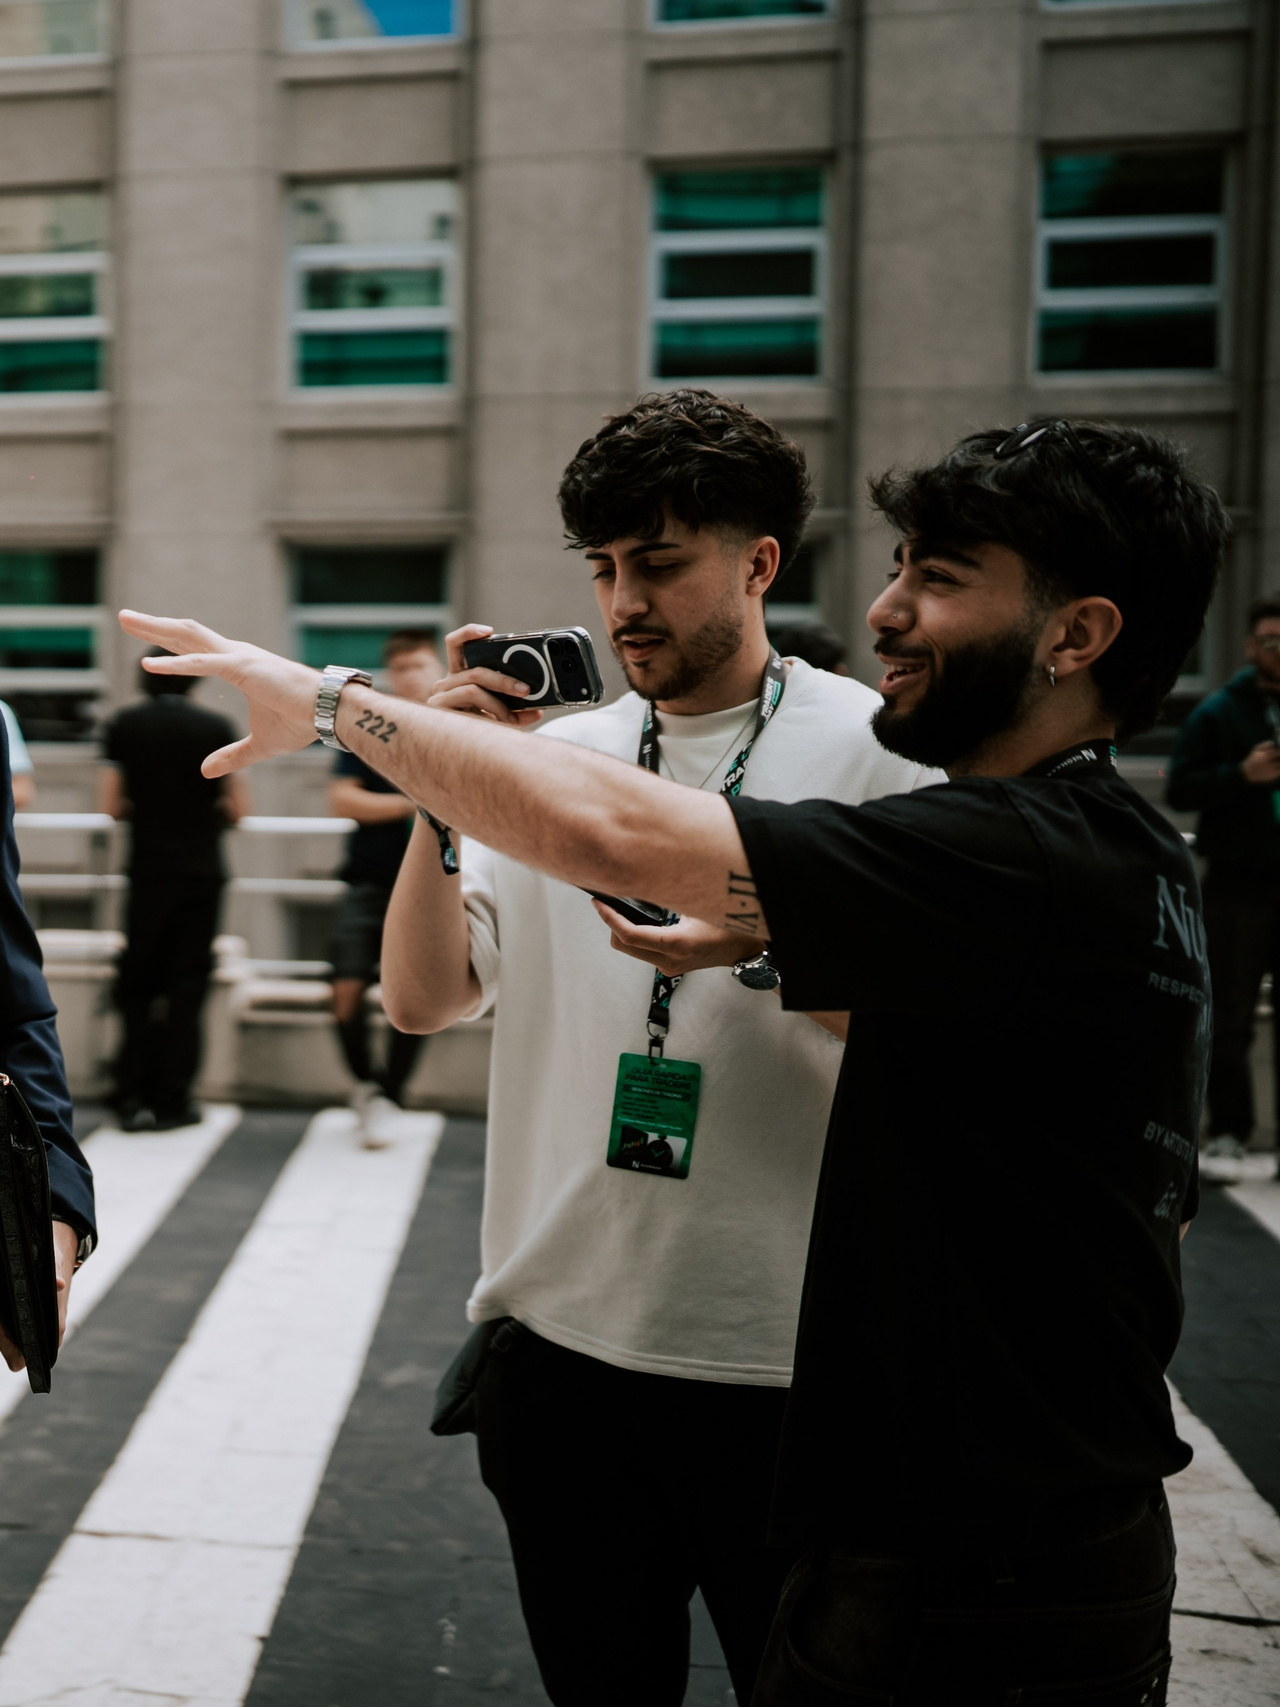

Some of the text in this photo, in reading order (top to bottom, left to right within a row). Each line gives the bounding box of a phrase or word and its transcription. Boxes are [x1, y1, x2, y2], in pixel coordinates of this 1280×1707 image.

[761, 676, 775, 717] TRADERS
[355, 709, 398, 744] 222
[625, 1073, 691, 1090] PARA TRADERS
[661, 1090, 683, 1099] TRADING
[1143, 1120, 1166, 1145] BY
